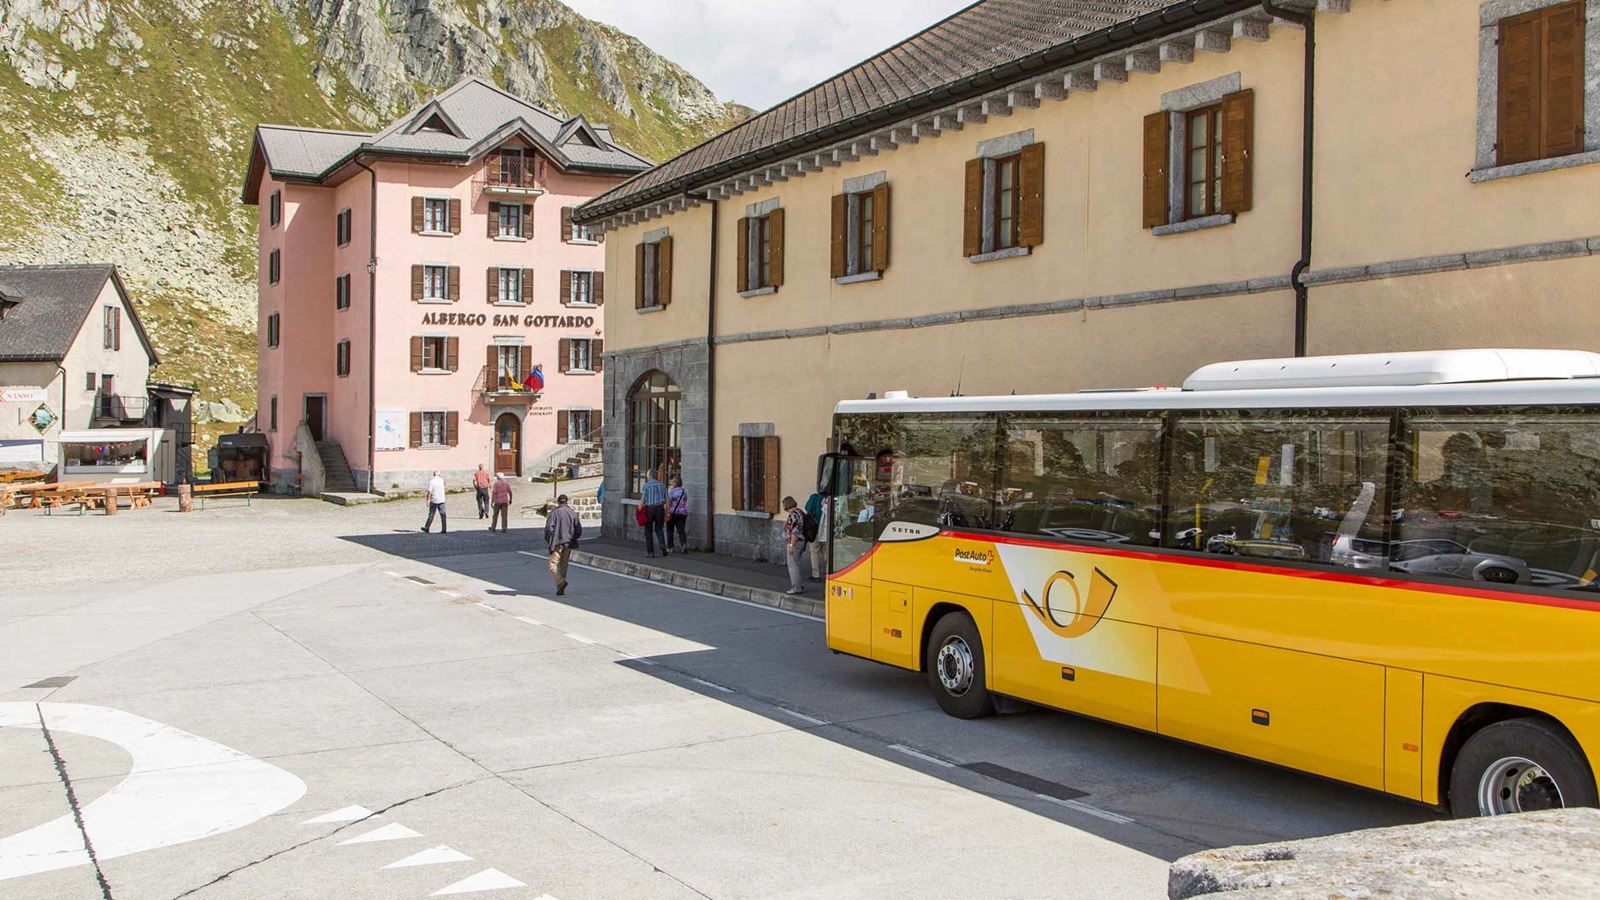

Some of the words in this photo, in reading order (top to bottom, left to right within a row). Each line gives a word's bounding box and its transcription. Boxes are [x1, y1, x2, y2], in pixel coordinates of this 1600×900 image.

[421, 312, 487, 326] ALBERGO
[492, 314, 519, 327] SAN
[523, 315, 594, 328] GOTTARDO
[891, 526, 921, 535] SETRA
[954, 547, 987, 562] PostAuto
